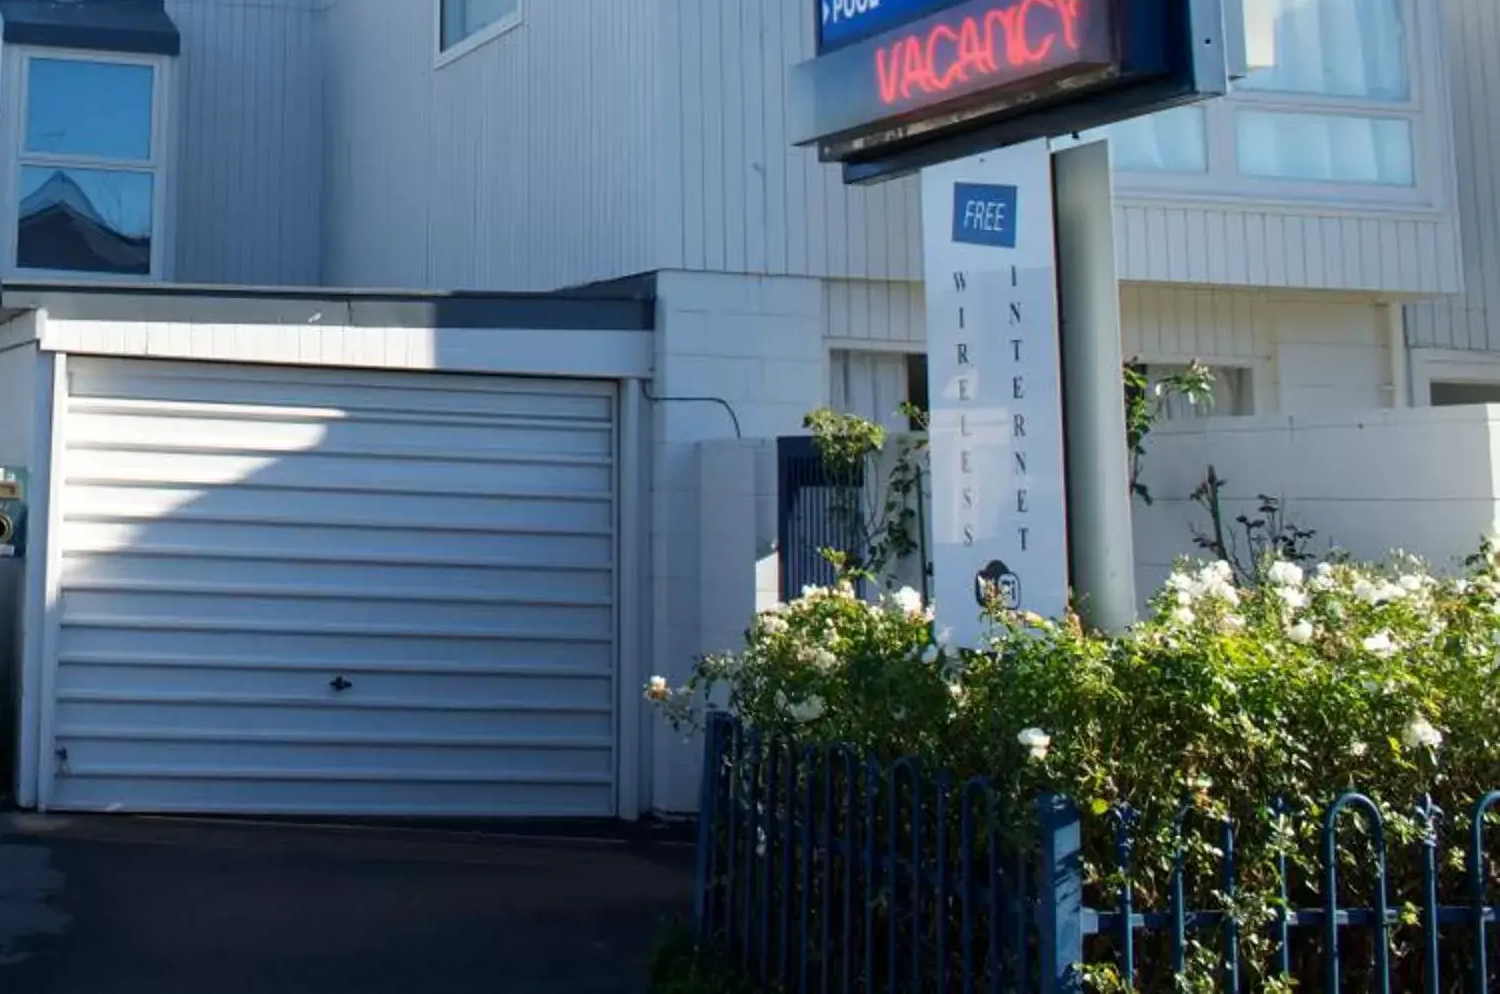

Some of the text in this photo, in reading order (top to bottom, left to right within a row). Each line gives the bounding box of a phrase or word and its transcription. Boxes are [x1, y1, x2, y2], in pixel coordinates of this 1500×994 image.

[963, 199, 1006, 231] FREE
[952, 270, 975, 548] WIRELESS
[1008, 264, 1030, 553] INTERNET
